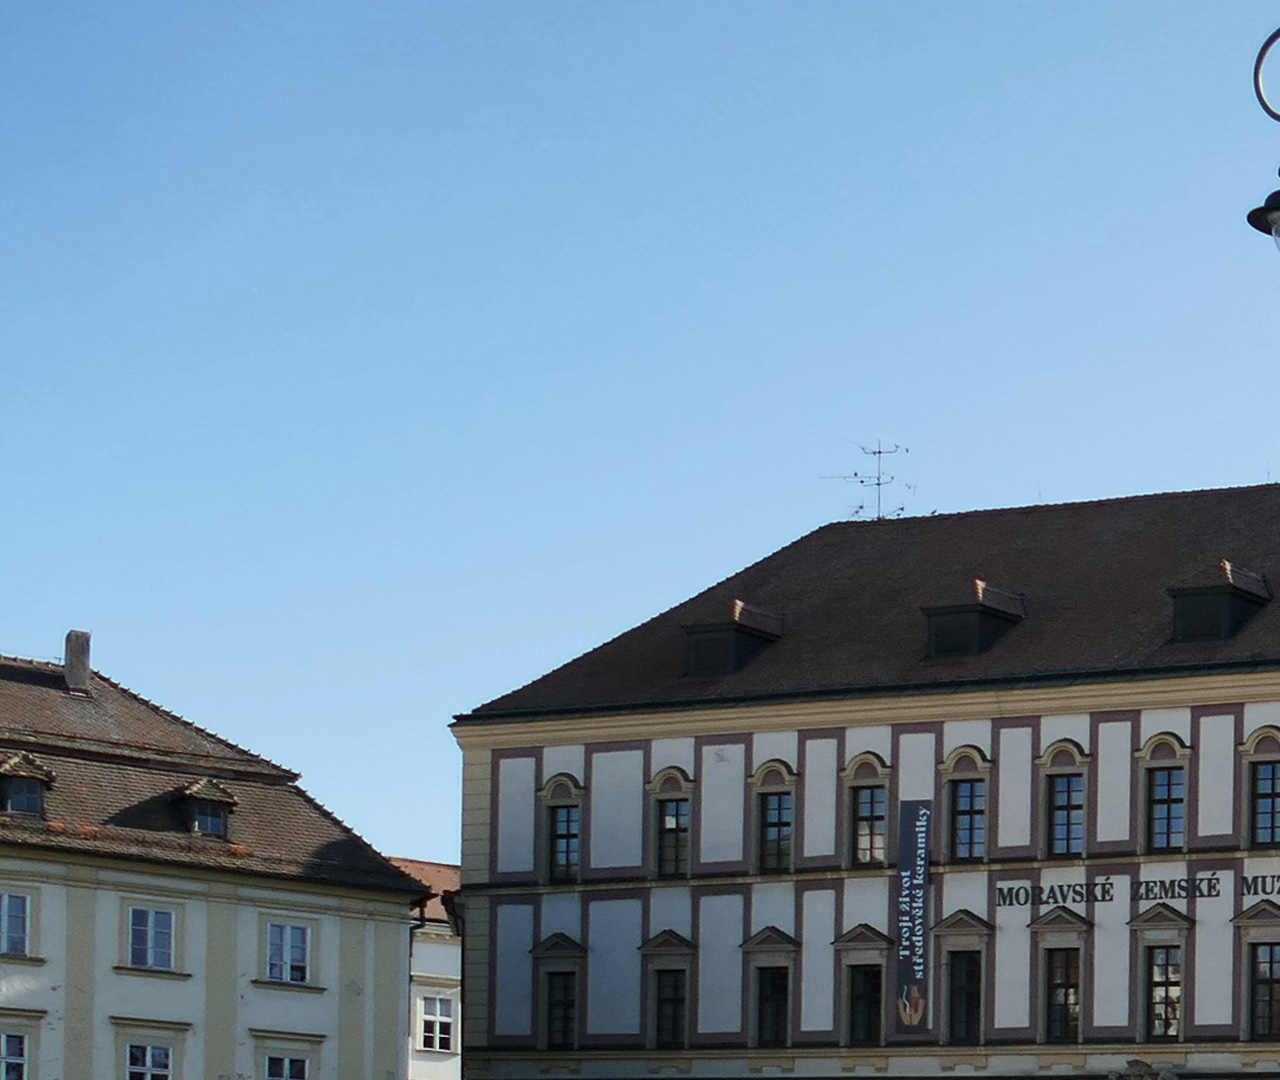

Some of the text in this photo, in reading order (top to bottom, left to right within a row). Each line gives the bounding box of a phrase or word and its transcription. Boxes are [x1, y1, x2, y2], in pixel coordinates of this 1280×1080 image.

[913, 805, 931, 885] keramiky
[996, 877, 1114, 907] MORAVSKÉ
[1131, 871, 1220, 901] ZEMSKÉ
